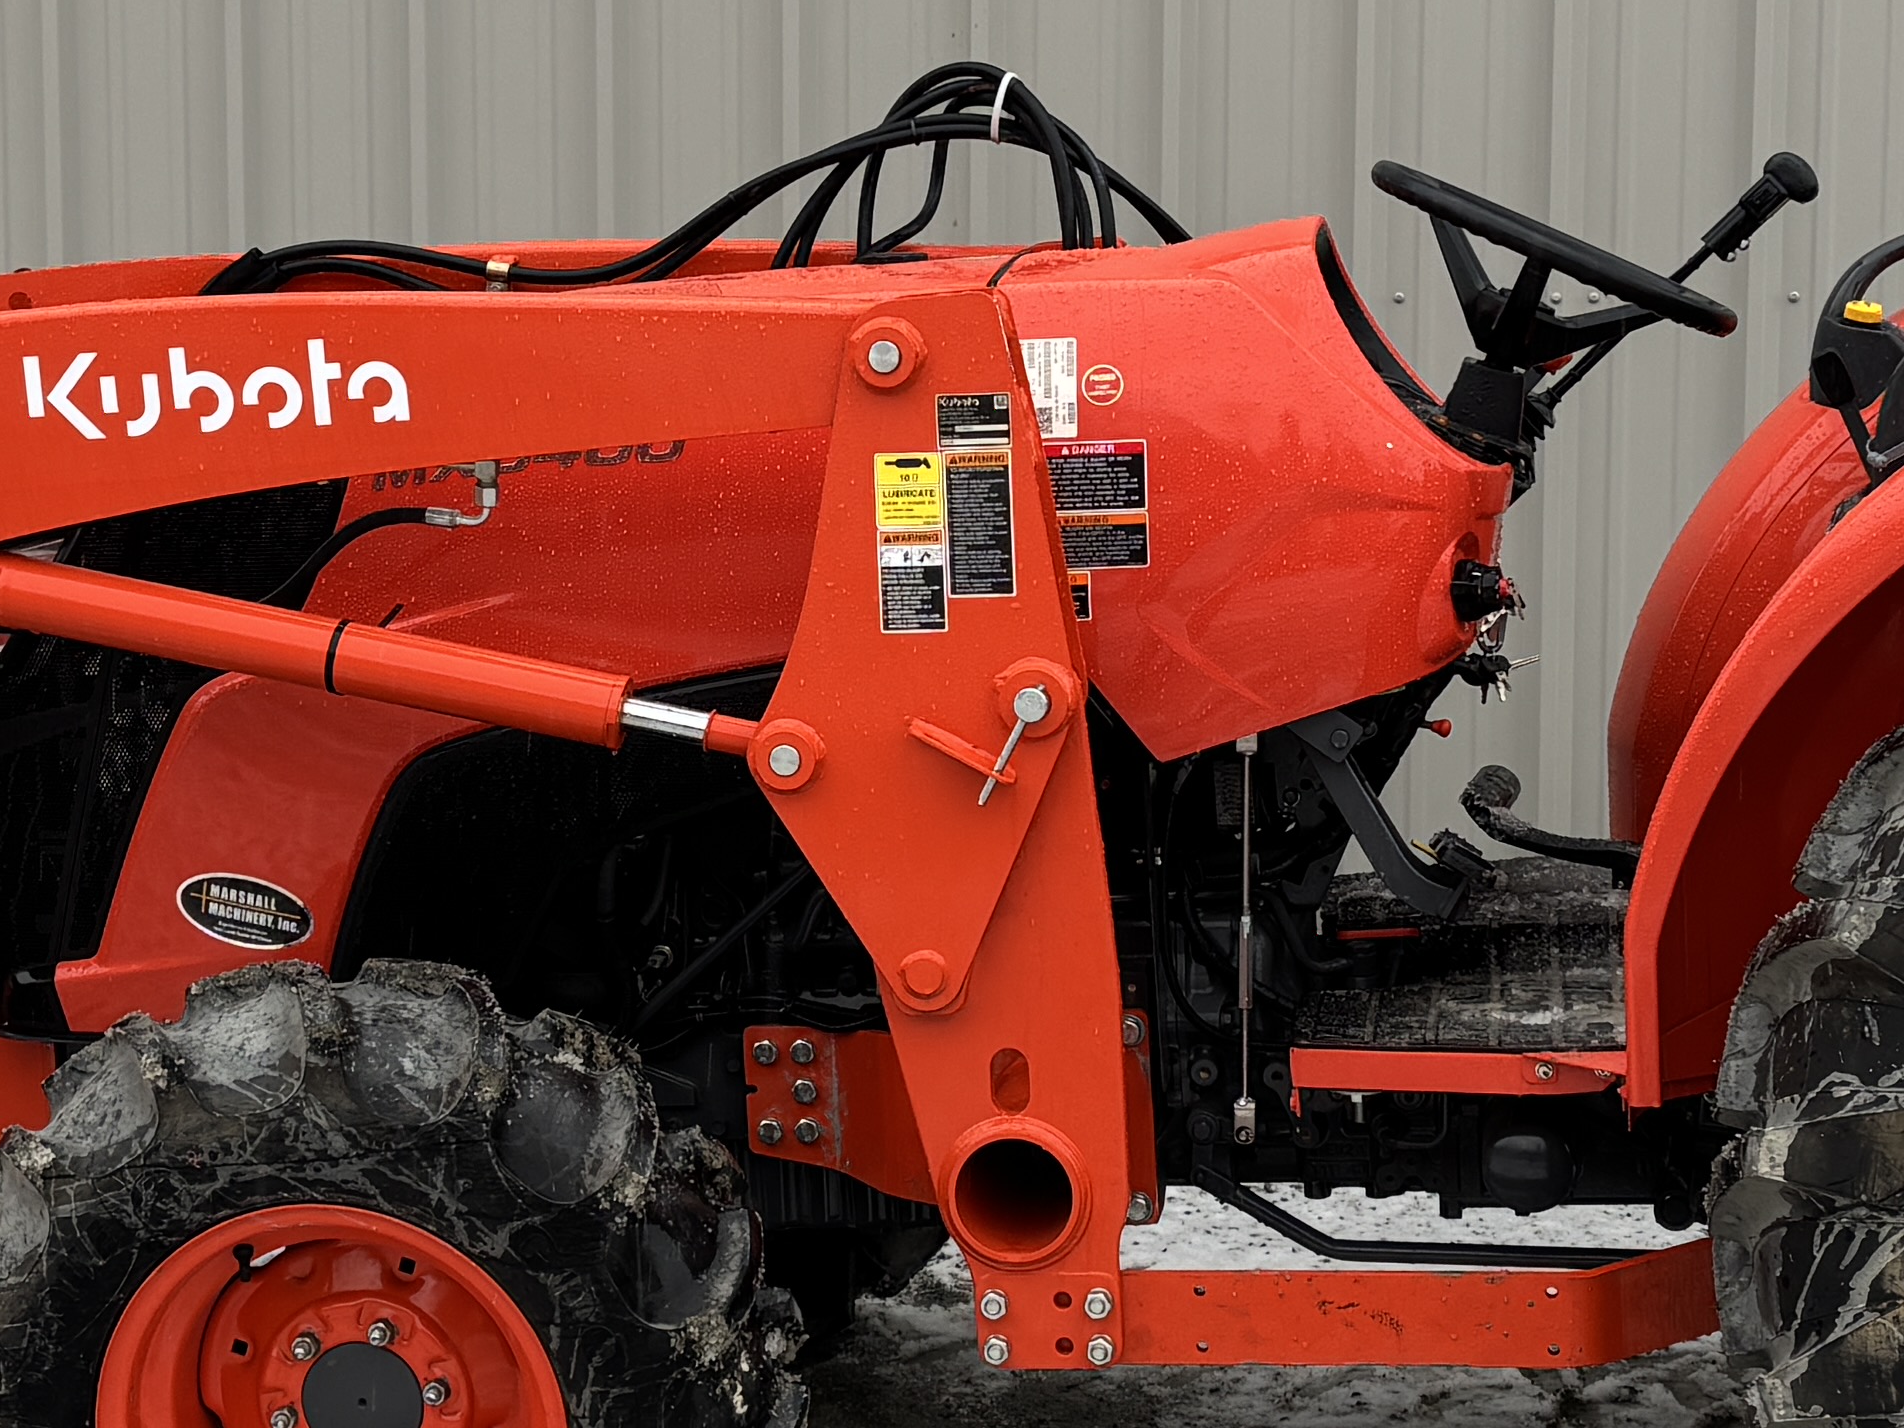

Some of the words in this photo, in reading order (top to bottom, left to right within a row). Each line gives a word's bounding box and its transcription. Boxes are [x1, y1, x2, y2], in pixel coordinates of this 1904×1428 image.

[21, 337, 412, 441] Kubota
[210, 883, 277, 911] MARSHALL
[208, 902, 276, 930] MACHINERY,
[277, 916, 300, 934] Inc.
